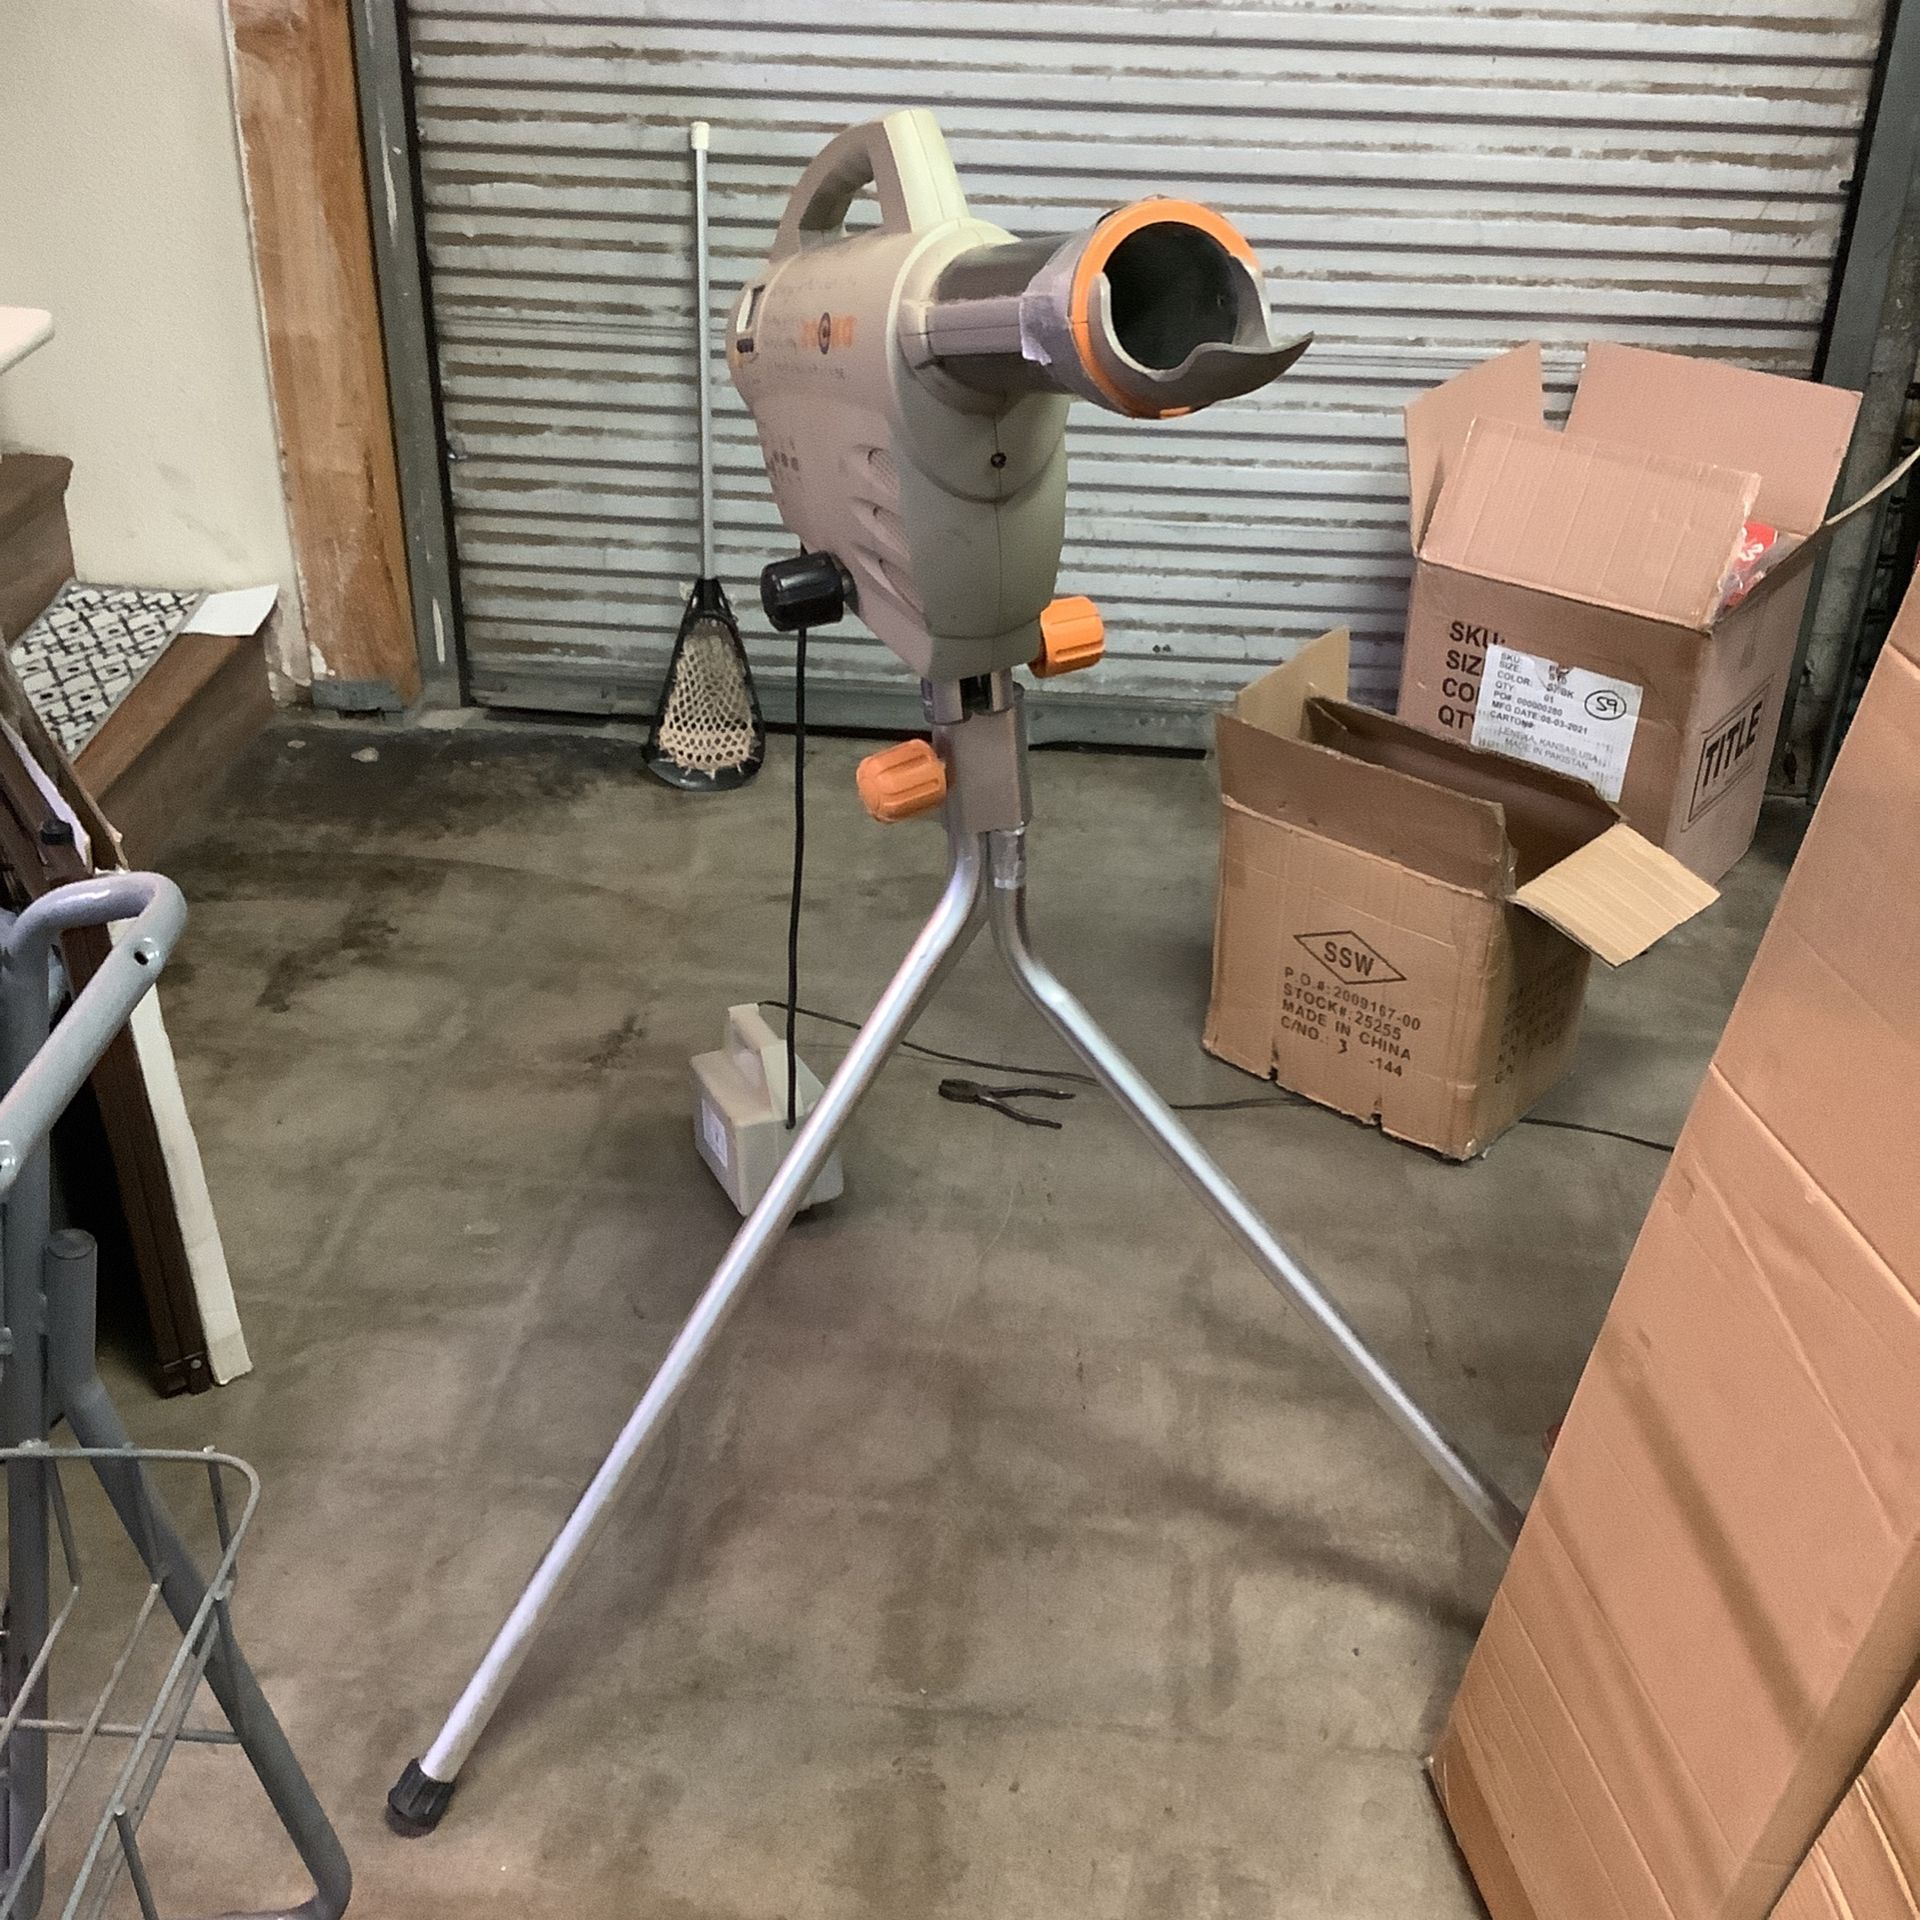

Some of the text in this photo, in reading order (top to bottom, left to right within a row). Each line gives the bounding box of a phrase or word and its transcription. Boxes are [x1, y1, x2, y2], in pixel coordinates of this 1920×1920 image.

[1702, 700, 1763, 788] TITLE
[1323, 940, 1375, 977] SSW
[1282, 998, 1411, 1061] MADE IN CHINA
